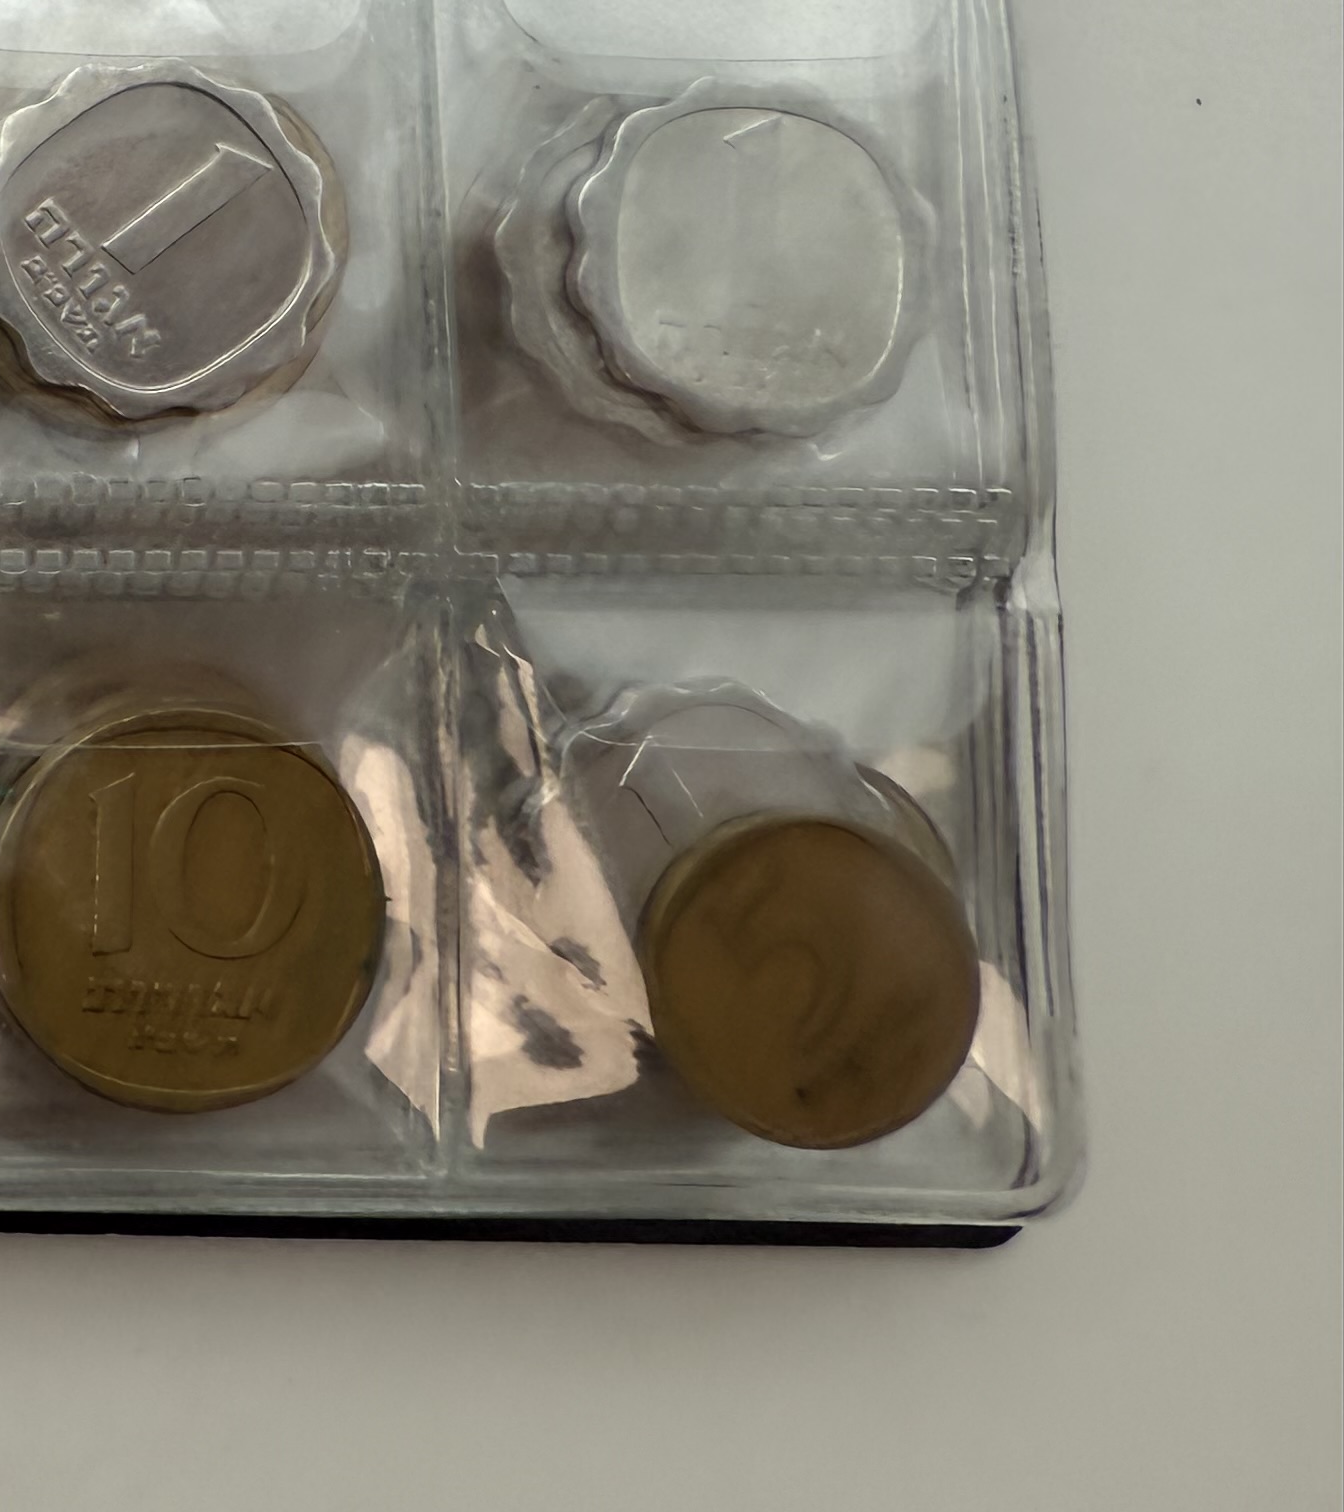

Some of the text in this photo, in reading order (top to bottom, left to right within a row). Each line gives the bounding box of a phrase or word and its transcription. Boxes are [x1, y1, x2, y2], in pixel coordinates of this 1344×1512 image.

[22, 196, 161, 359] אגורה
[100, 141, 274, 276] 1
[87, 771, 311, 962] 10
